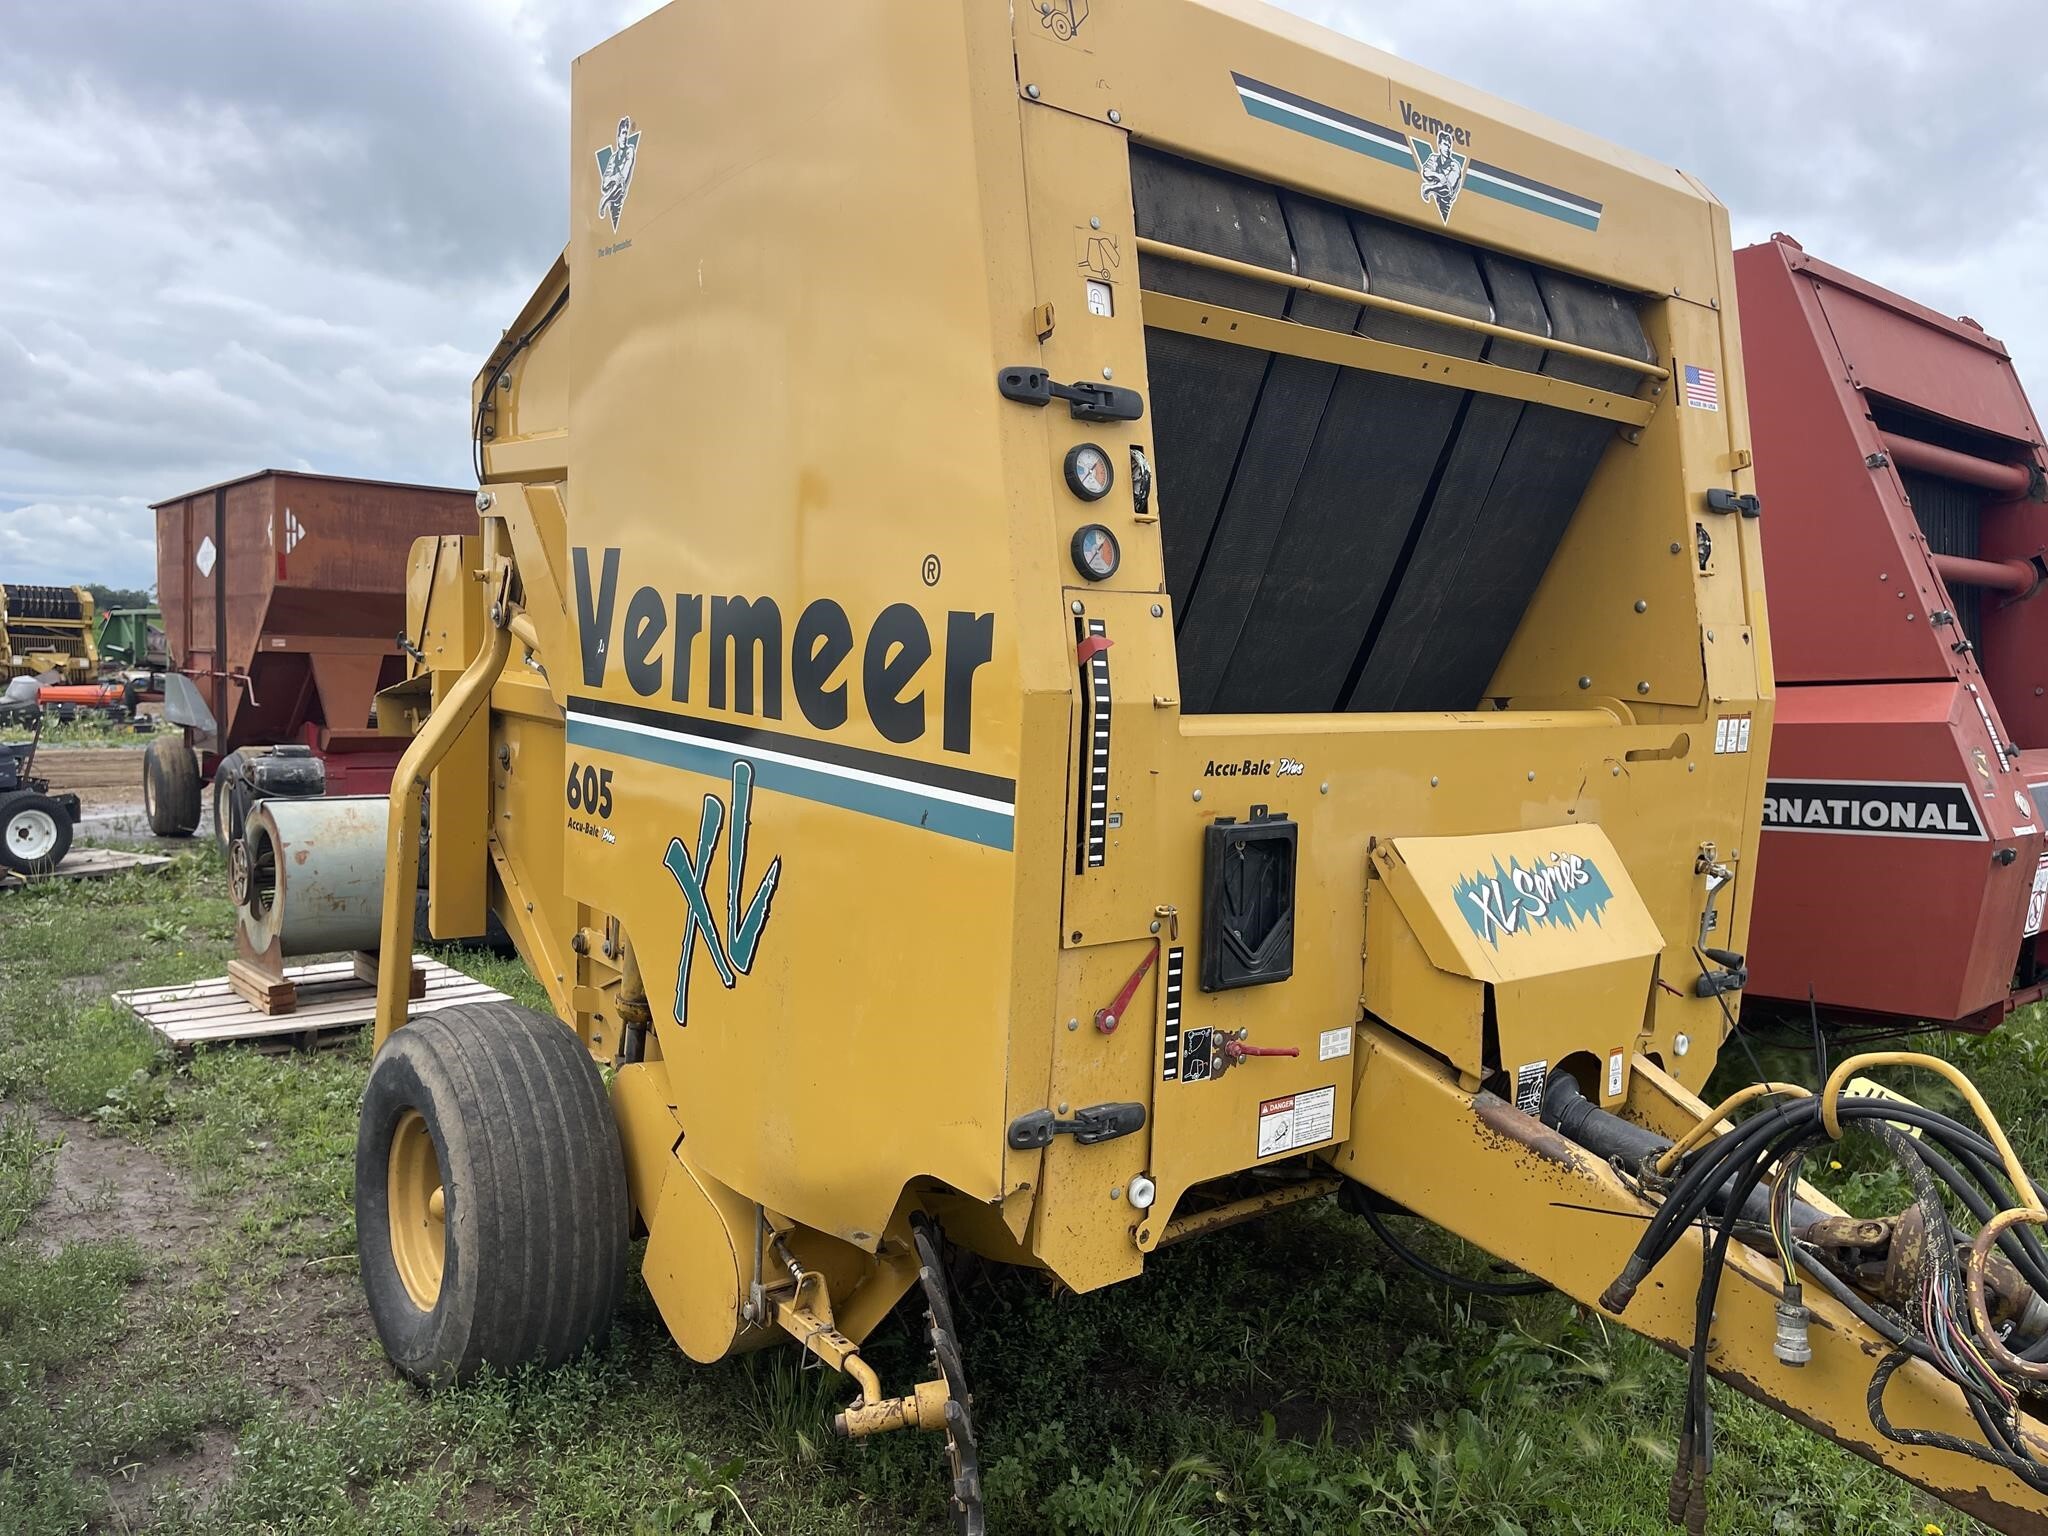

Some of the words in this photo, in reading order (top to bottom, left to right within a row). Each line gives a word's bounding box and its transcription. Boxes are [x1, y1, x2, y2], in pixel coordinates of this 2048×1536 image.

[1399, 100, 1471, 147] Vermeer
[571, 547, 995, 755] Vermeer
[567, 762, 613, 819] 605
[1204, 759, 1271, 777] Accu-Bale
[1276, 757, 1304, 778] Plus
[568, 817, 599, 837] Accu-Bale
[663, 759, 782, 1027] XL
[1467, 879, 1522, 943] XL
[1512, 851, 1591, 917] Series
[1269, 1099, 1294, 1112] DANGER
